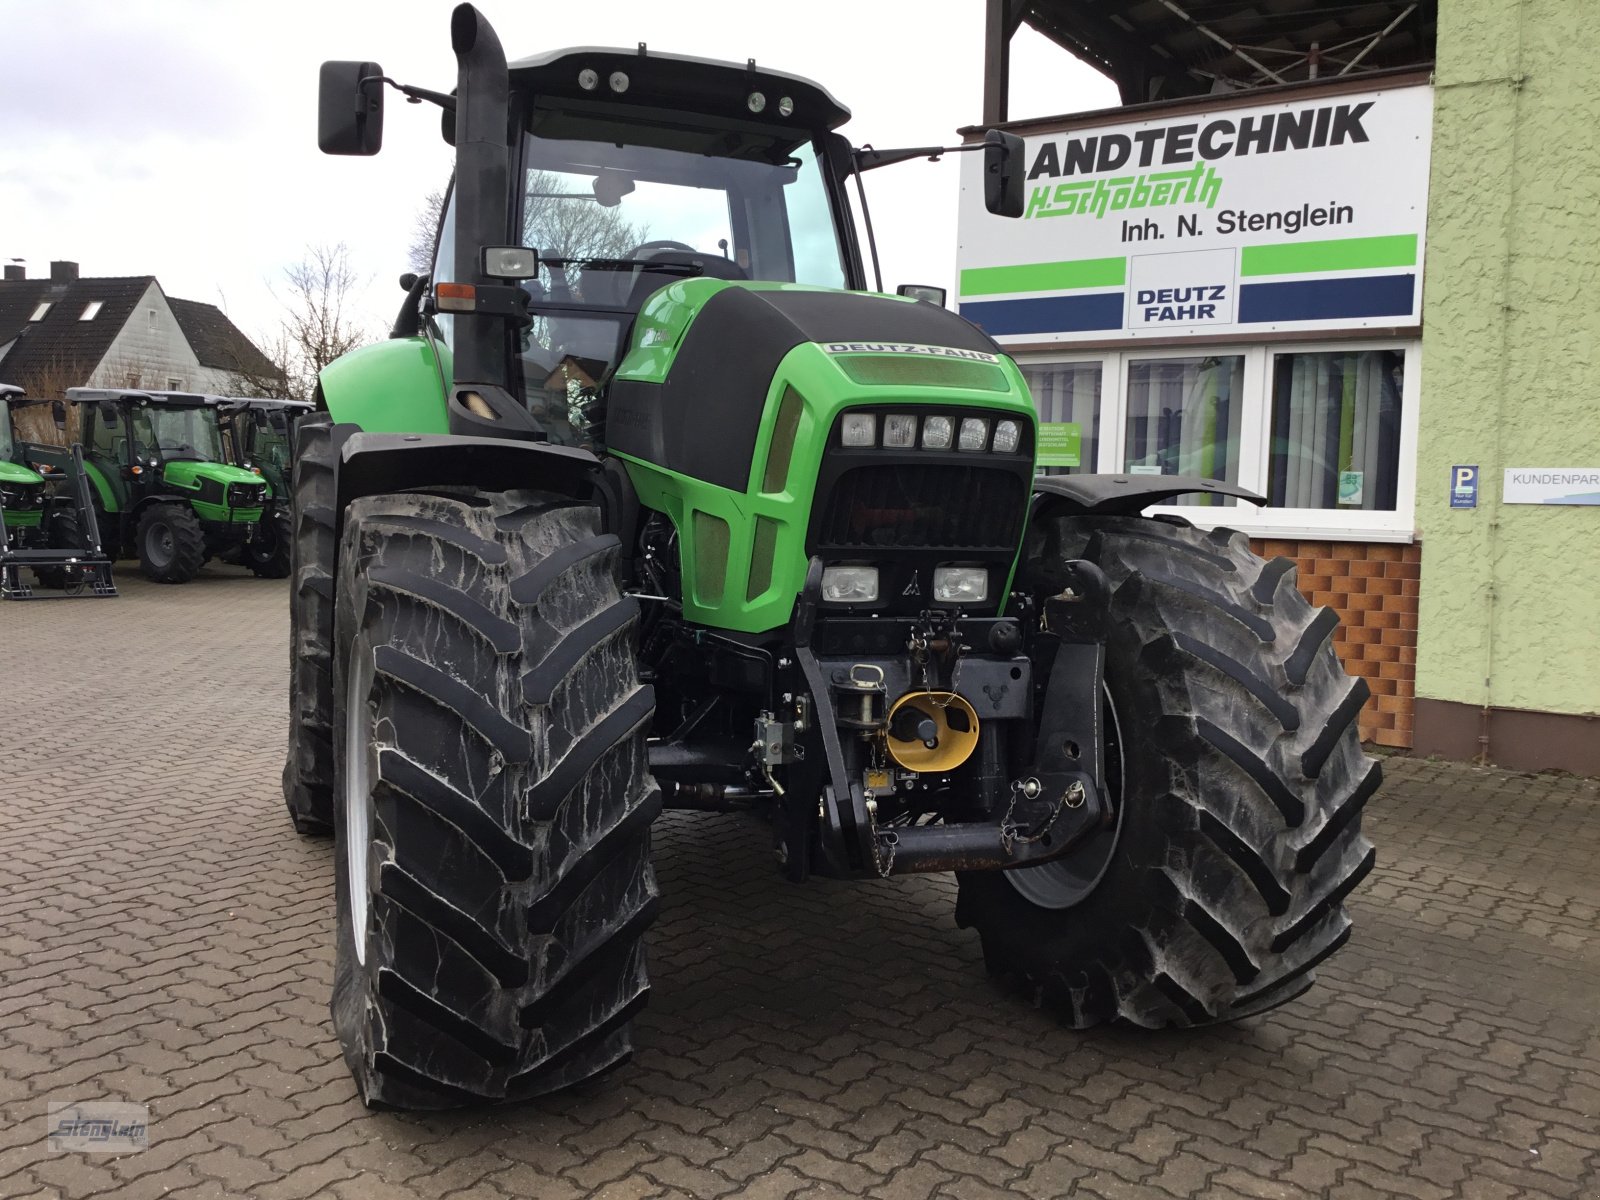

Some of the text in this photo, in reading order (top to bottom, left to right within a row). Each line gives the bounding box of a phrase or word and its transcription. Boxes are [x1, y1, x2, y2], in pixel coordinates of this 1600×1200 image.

[1024, 101, 1376, 181] ANDTECHNIK
[1121, 201, 1354, 242] Inh. N. Stenglein
[1137, 285, 1226, 305] DEUTZ
[1144, 303, 1216, 322] FAHR
[829, 344, 995, 362] DEUTZ-FAHR
[1456, 468, 1474, 487] P
